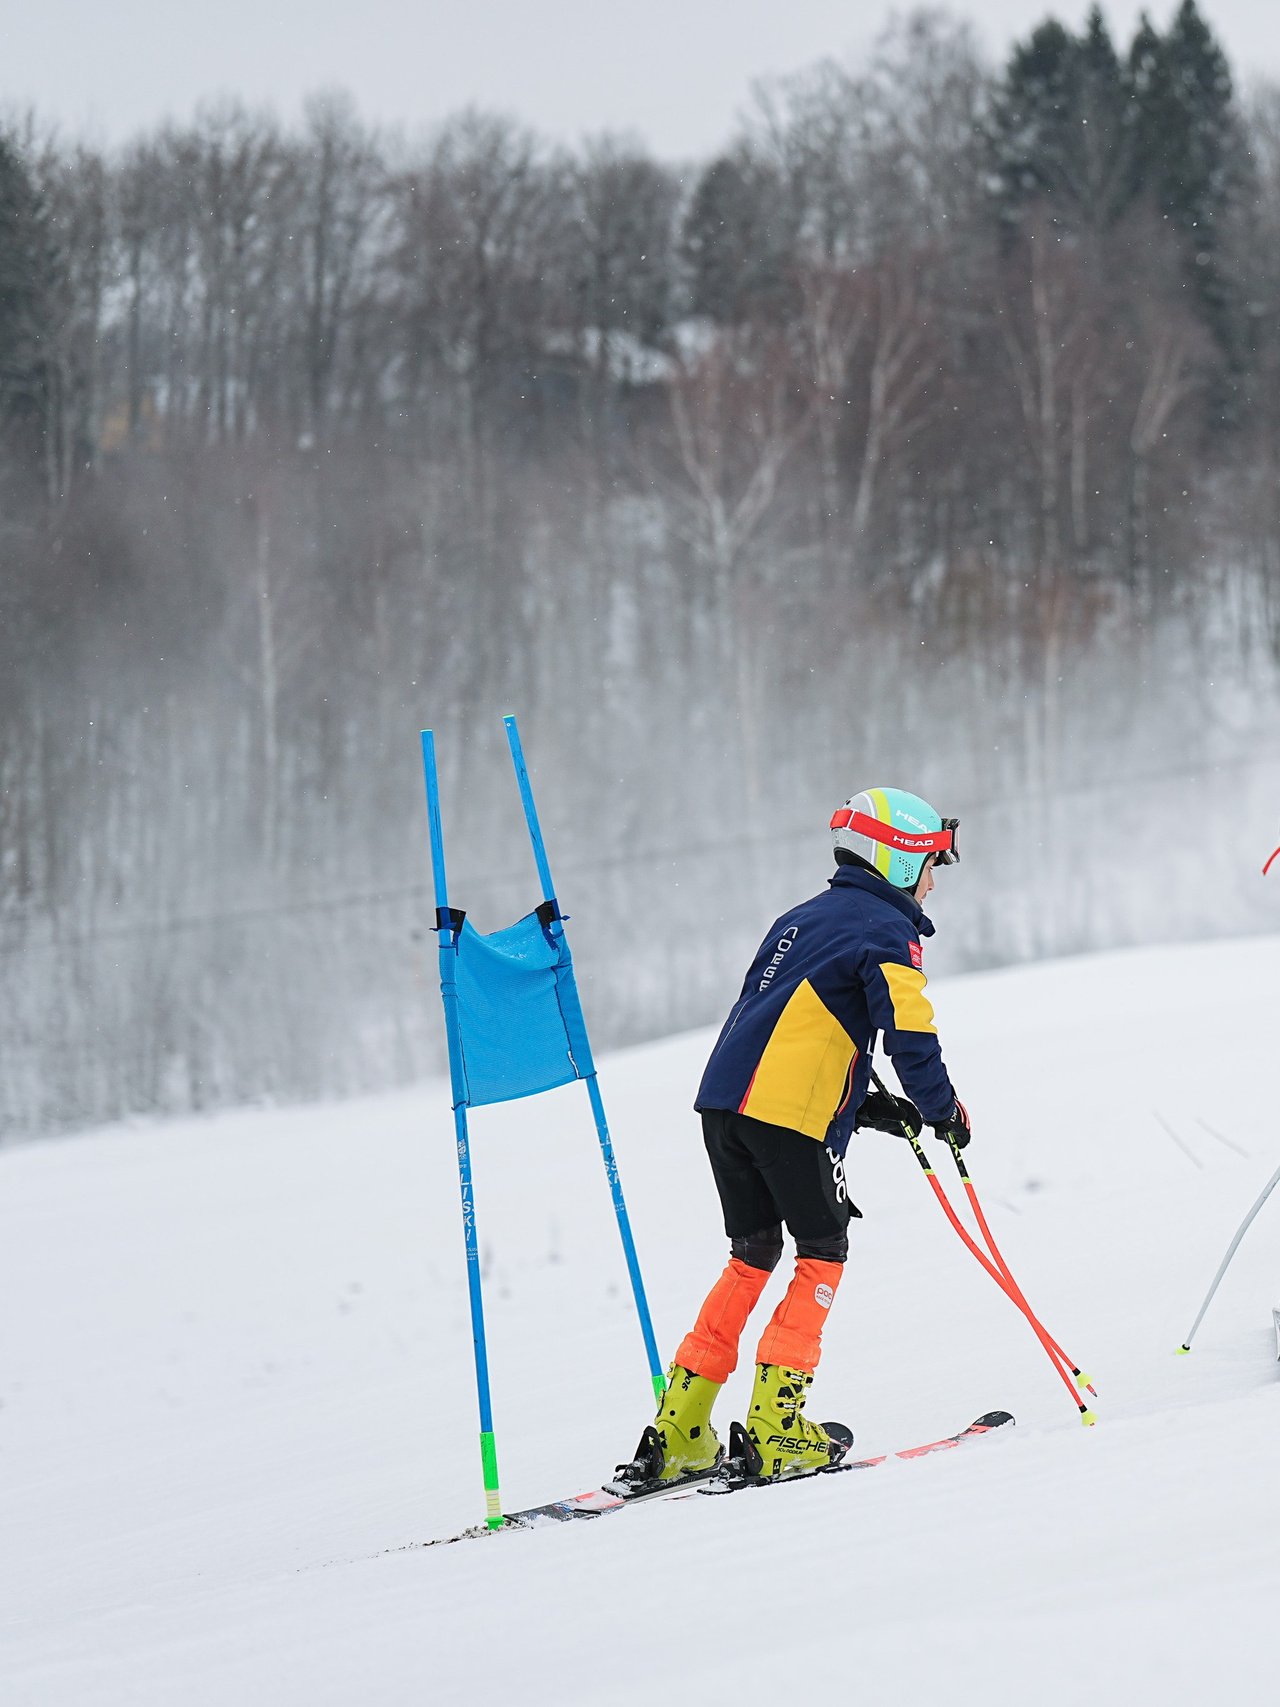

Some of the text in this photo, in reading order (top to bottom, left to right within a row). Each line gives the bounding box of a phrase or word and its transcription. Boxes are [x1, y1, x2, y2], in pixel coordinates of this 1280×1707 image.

[896, 810, 933, 834] HEA
[893, 835, 934, 847] HEAD
[461, 1174, 473, 1241] LISKI
